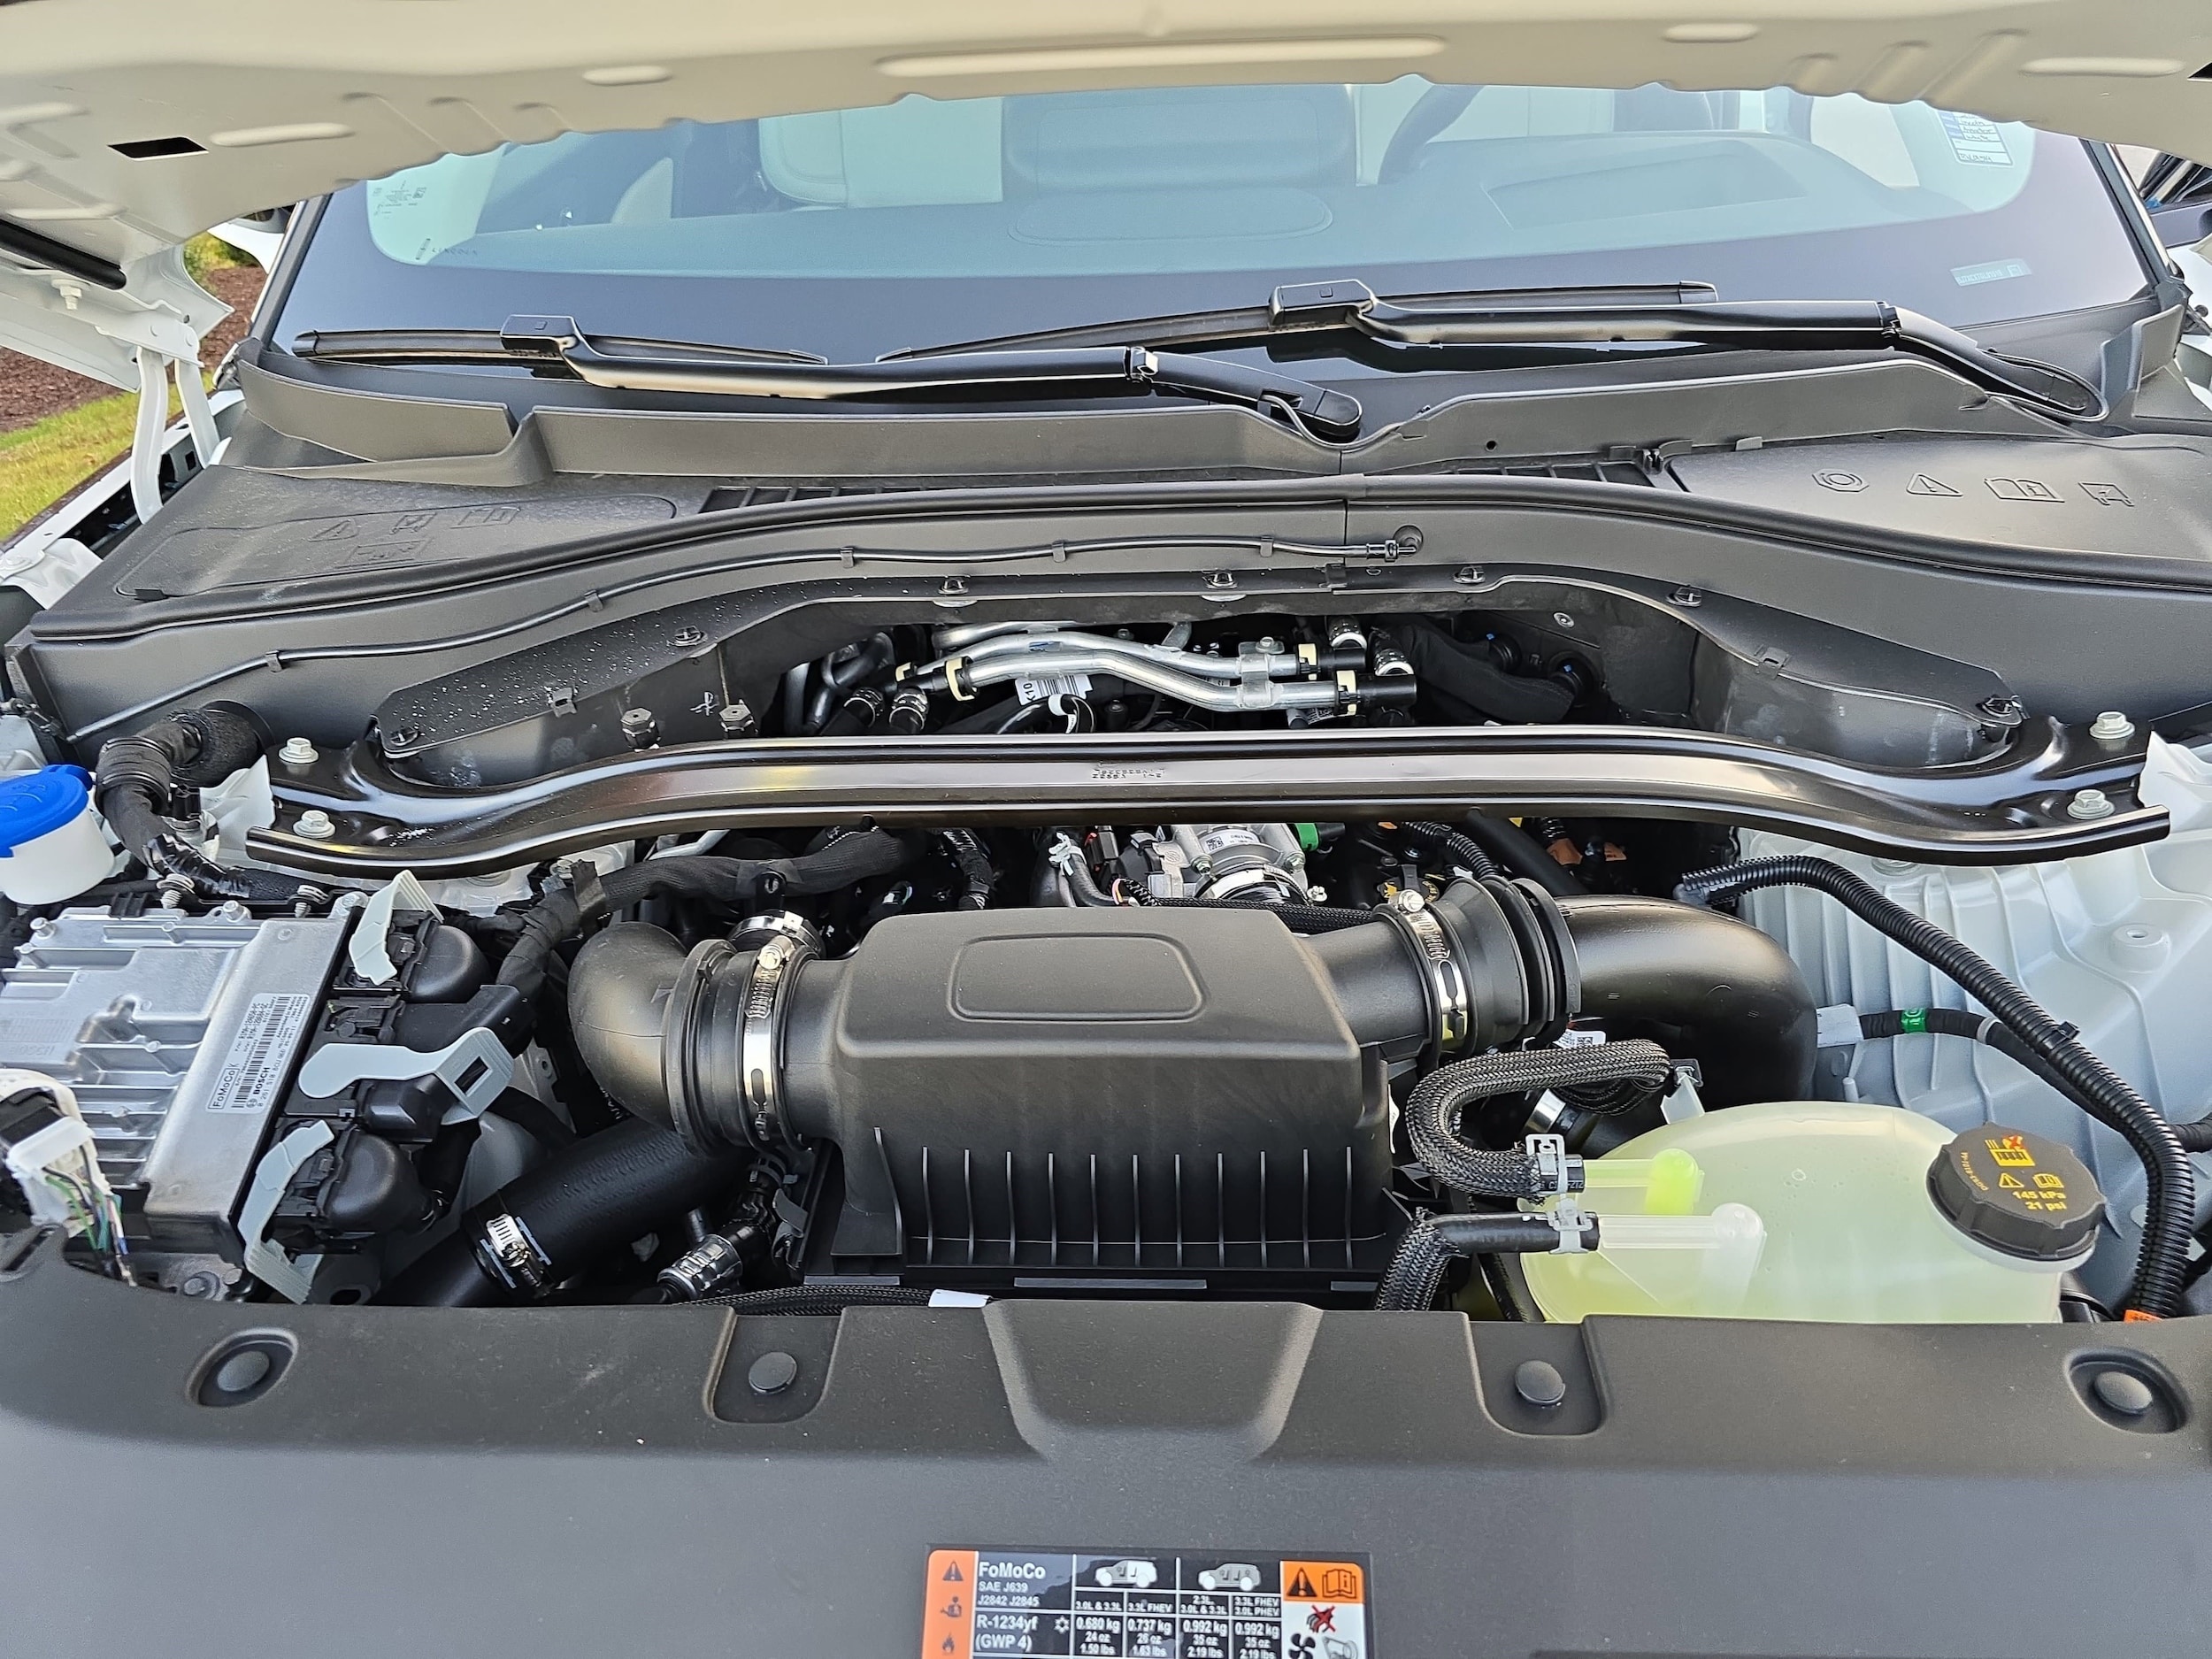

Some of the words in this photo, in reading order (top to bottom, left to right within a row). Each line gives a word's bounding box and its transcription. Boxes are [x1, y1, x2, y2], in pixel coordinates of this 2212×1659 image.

[253, 1067, 270, 1094] BOSCH
[213, 1070, 235, 1107] FoMoCo
[2013, 1191, 2038, 1200] 145
[2039, 1191, 2066, 1200] kPa
[2025, 1202, 2043, 1210] 21
[2046, 1202, 2067, 1211] psi
[979, 1562, 1046, 1579] FoMoCo
[979, 1581, 1001, 1592] SAE
[1003, 1582, 1028, 1593] J639
[978, 1594, 1008, 1606] J2842
[1010, 1595, 1040, 1607] J2845
[1076, 1601, 1094, 1610] 3.0L
[1094, 1601, 1102, 1610] &
[1103, 1601, 1122, 1611] 3.3L
[1234, 1596, 1254, 1607] 3.3L
[1254, 1597, 1280, 1608] FHEV
[1128, 1602, 1147, 1612] 3.3L
[1147, 1602, 1174, 1613] FHEV
[1180, 1604, 1199, 1614] 3.0L
[1200, 1604, 1208, 1614] &
[1209, 1605, 1227, 1615] 3.3L
[1234, 1606, 1254, 1616] 3.0L
[1254, 1607, 1279, 1617] PHEV
[976, 1614, 1039, 1633] R-1234yf
[1076, 1617, 1105, 1630] 0.680
[1106, 1617, 1121, 1634] kg
[1127, 1618, 1156, 1632] 0.737
[1157, 1619, 1172, 1636] kg
[1182, 1619, 1212, 1633] 0.992
[1213, 1620, 1228, 1637] kg
[1085, 1631, 1097, 1642] 24
[1098, 1633, 1111, 1643] oz
[1234, 1622, 1264, 1636] 0.992
[1265, 1623, 1280, 1640] kg
[975, 1633, 1016, 1651] (GWP
[1018, 1634, 1033, 1652] 4)
[1136, 1632, 1149, 1644] 26
[1150, 1635, 1163, 1645] oz
[1193, 1634, 1206, 1646] 35
[1206, 1636, 1219, 1647] oz
[1245, 1636, 1258, 1648] 35
[1258, 1639, 1271, 1649] oz
[1100, 1643, 1116, 1655] lbs
[1133, 1645, 1151, 1656] 1.63
[1152, 1645, 1167, 1657] lbs
[1187, 1646, 1208, 1658] 2.19
[1208, 1647, 1225, 1659] lbs
[1239, 1648, 1260, 1659] 2.19
[1260, 1649, 1277, 1659] lbs
